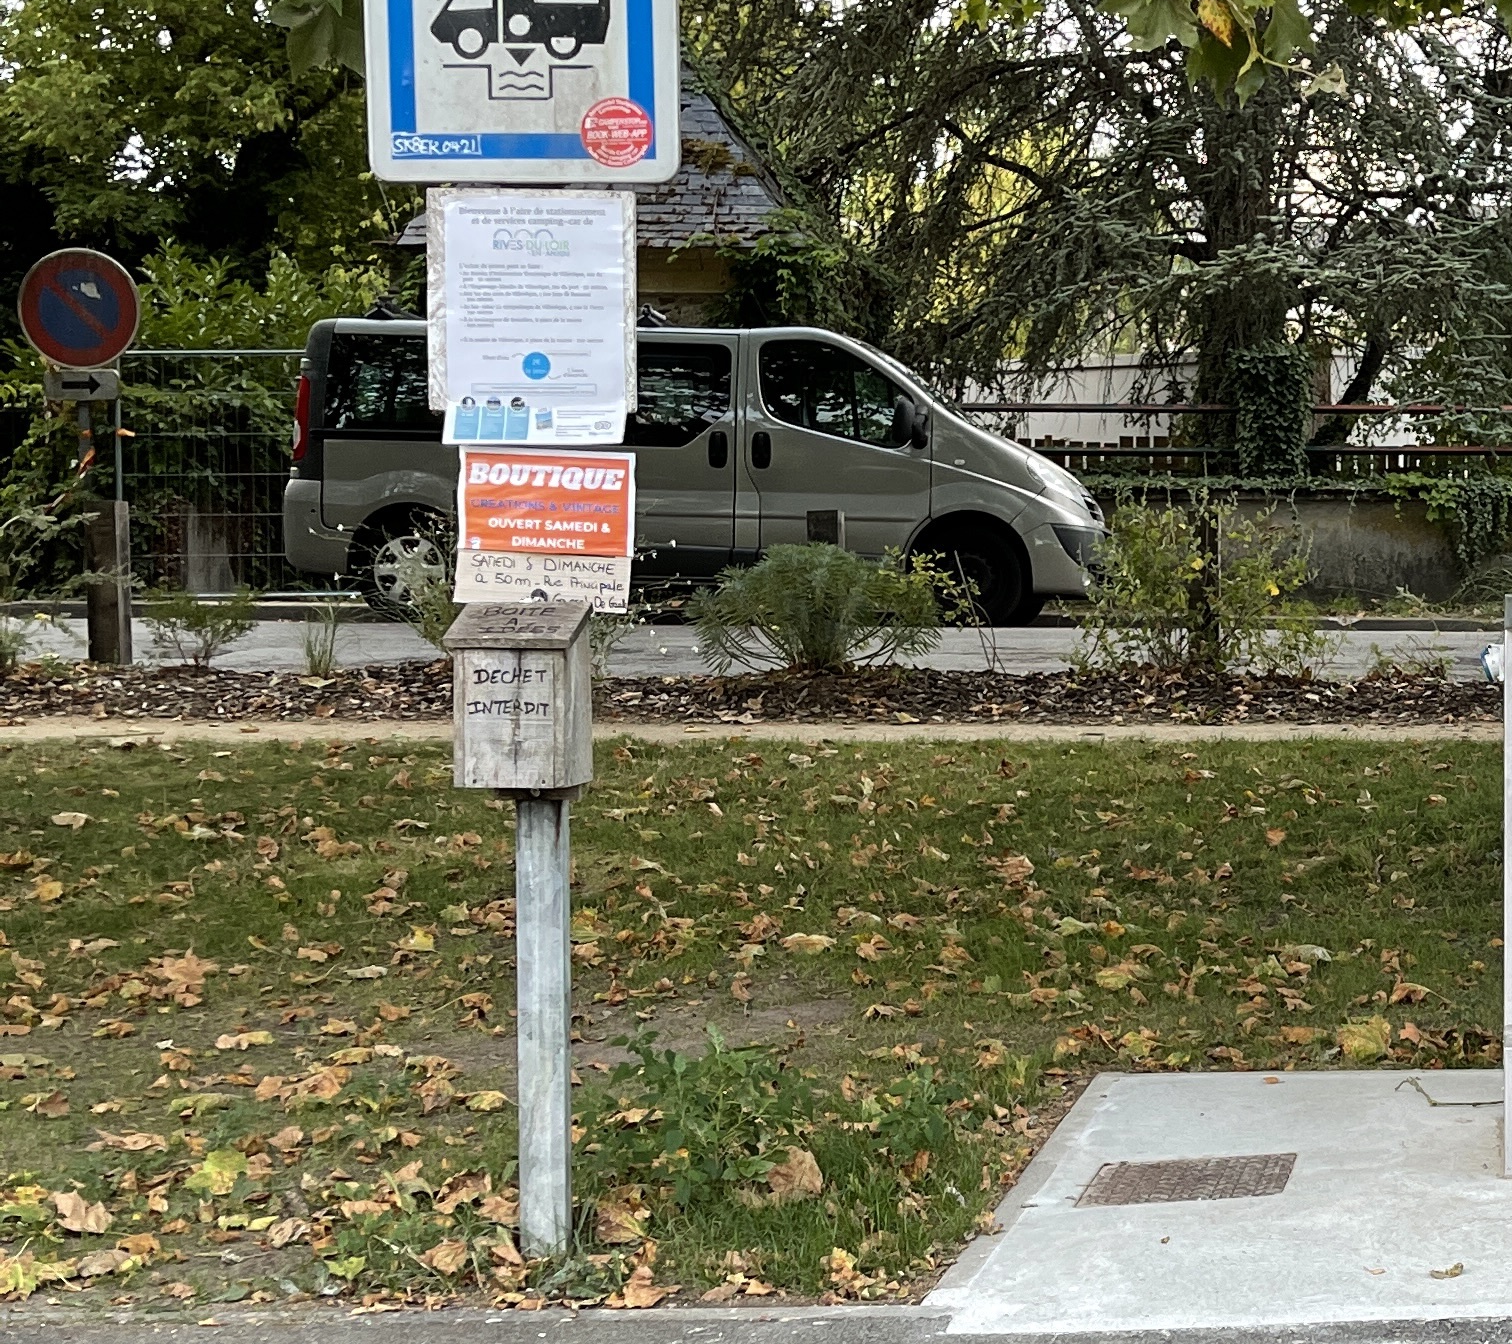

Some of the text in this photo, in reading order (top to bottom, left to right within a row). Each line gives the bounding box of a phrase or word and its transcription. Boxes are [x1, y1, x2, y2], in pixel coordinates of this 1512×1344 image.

[492, 240, 523, 250] RIVES
[469, 462, 625, 491] BOUTIQUE
[488, 518, 611, 534] OUVERT SAMEDI &
[511, 536, 586, 550] DIMANCHE
[544, 558, 616, 575] DIMANCHE
[483, 607, 556, 617] BOITE
[473, 667, 547, 684] DECHET
[466, 699, 549, 716] INTERDIT
